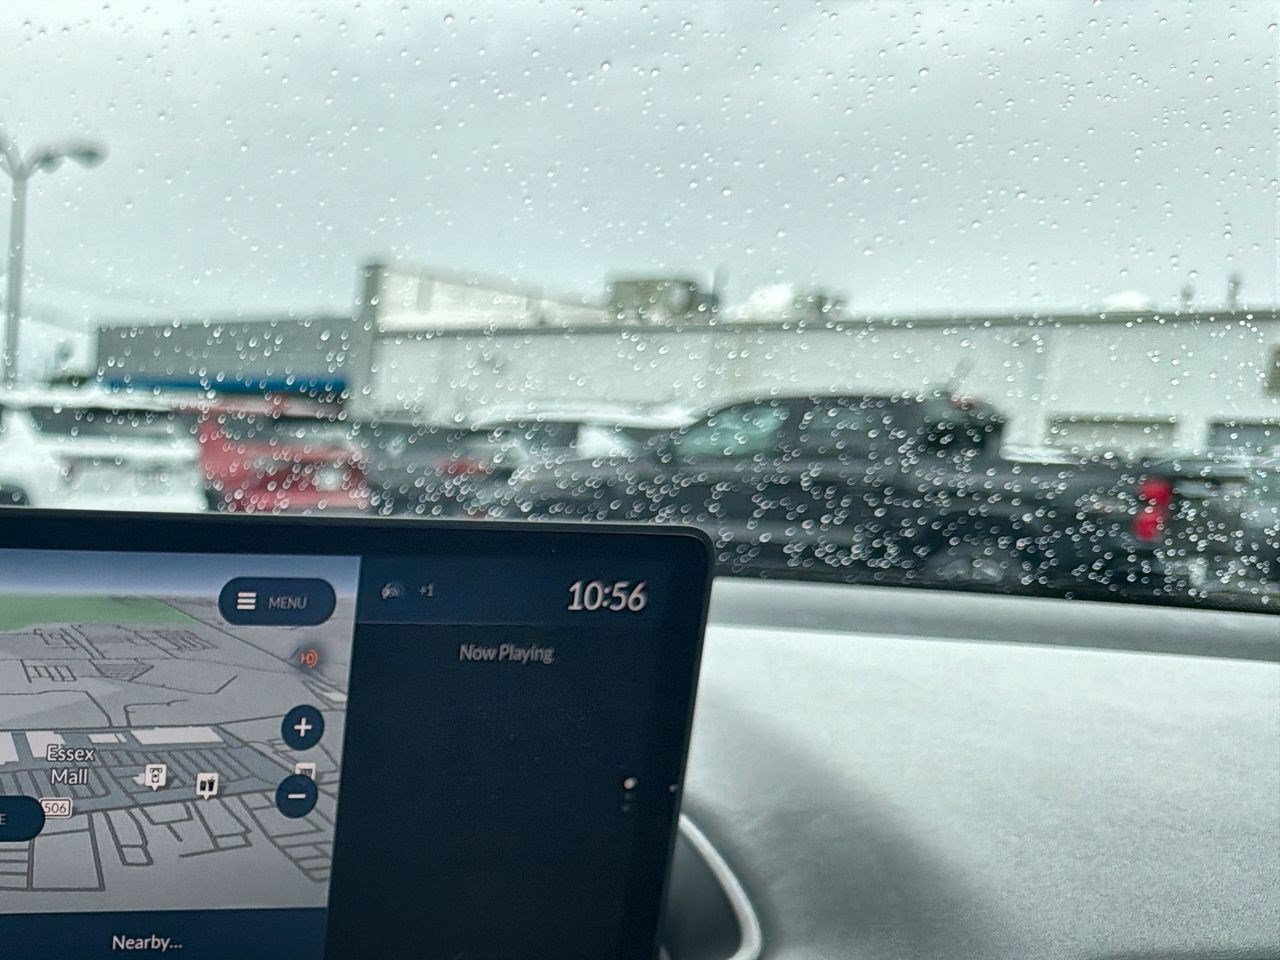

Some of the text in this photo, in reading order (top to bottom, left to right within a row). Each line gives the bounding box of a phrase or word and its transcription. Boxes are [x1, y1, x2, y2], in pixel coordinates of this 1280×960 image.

[267, 595, 307, 610] MENU
[567, 580, 647, 612] 10:56
[459, 644, 555, 665] Now Playing
[46, 744, 95, 762] Essex
[50, 768, 88, 786] Mall
[44, 802, 67, 814] 506
[112, 935, 183, 952] Nearby...
